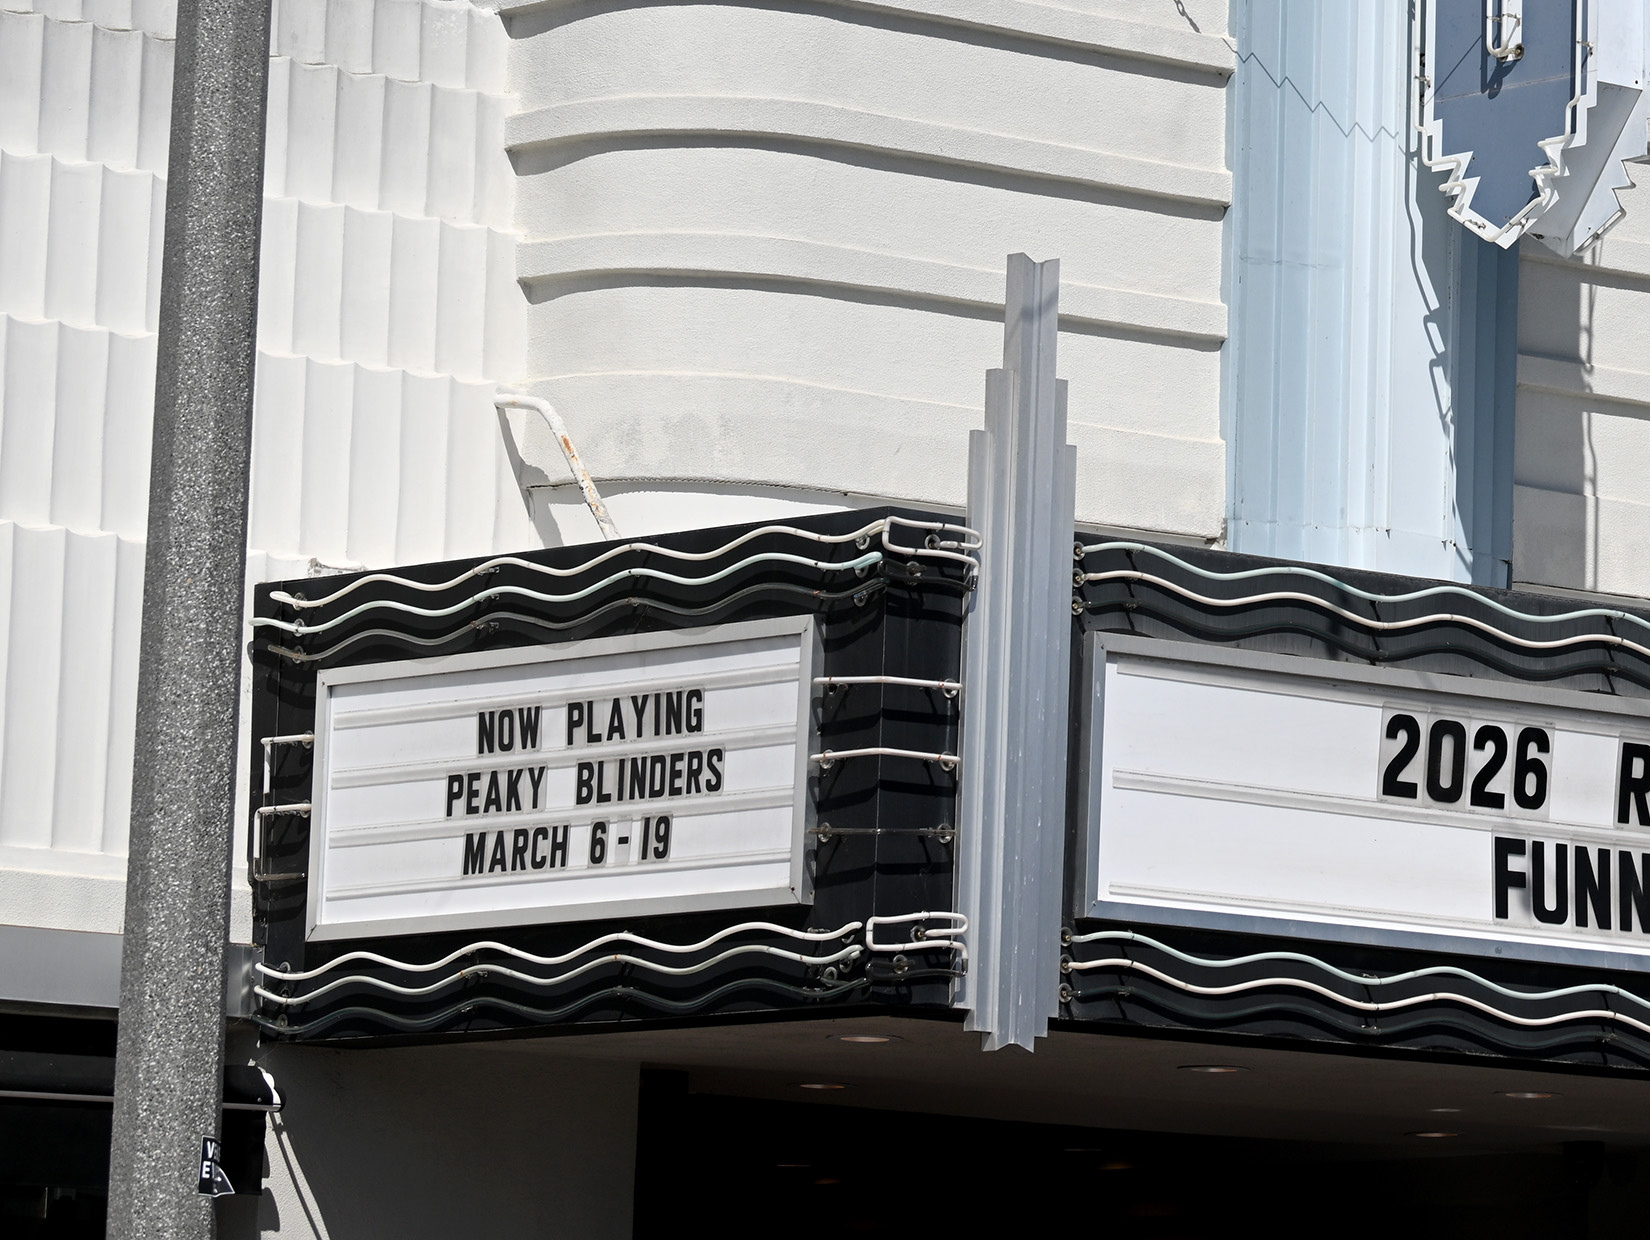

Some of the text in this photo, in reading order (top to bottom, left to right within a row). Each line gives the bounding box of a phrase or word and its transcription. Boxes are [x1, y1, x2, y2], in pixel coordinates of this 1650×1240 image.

[479, 689, 702, 754] NOW PLAYING
[447, 749, 722, 816] PEAKY BLINDERS
[1383, 714, 1549, 809] 2026
[463, 825, 568, 875] MARCH
